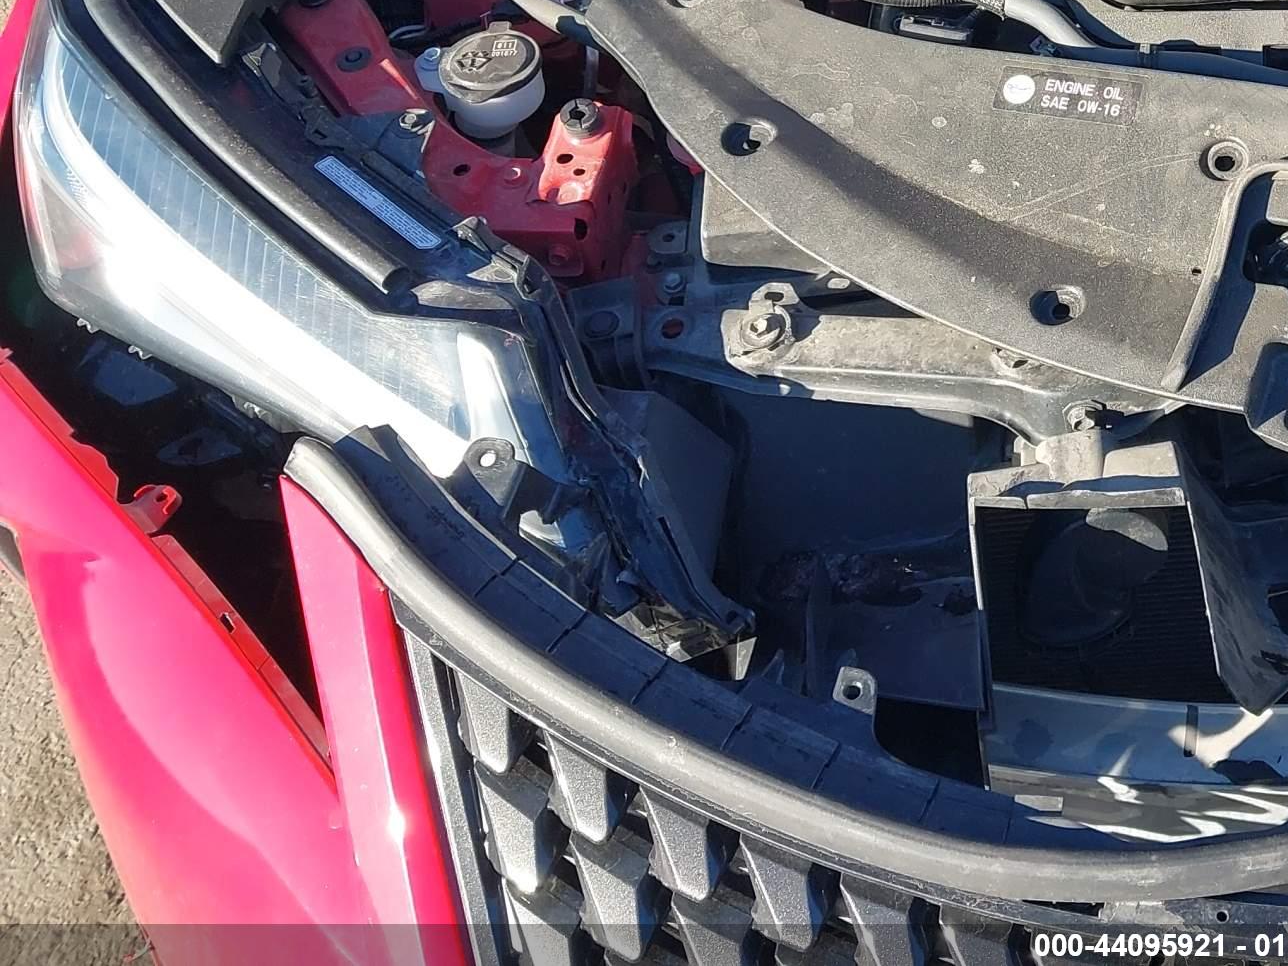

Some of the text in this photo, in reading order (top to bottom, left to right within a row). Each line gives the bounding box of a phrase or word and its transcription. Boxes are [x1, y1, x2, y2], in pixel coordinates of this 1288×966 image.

[1044, 78, 1124, 101] ENGINE OIL
[1040, 94, 1121, 117] SAE 0W-16
